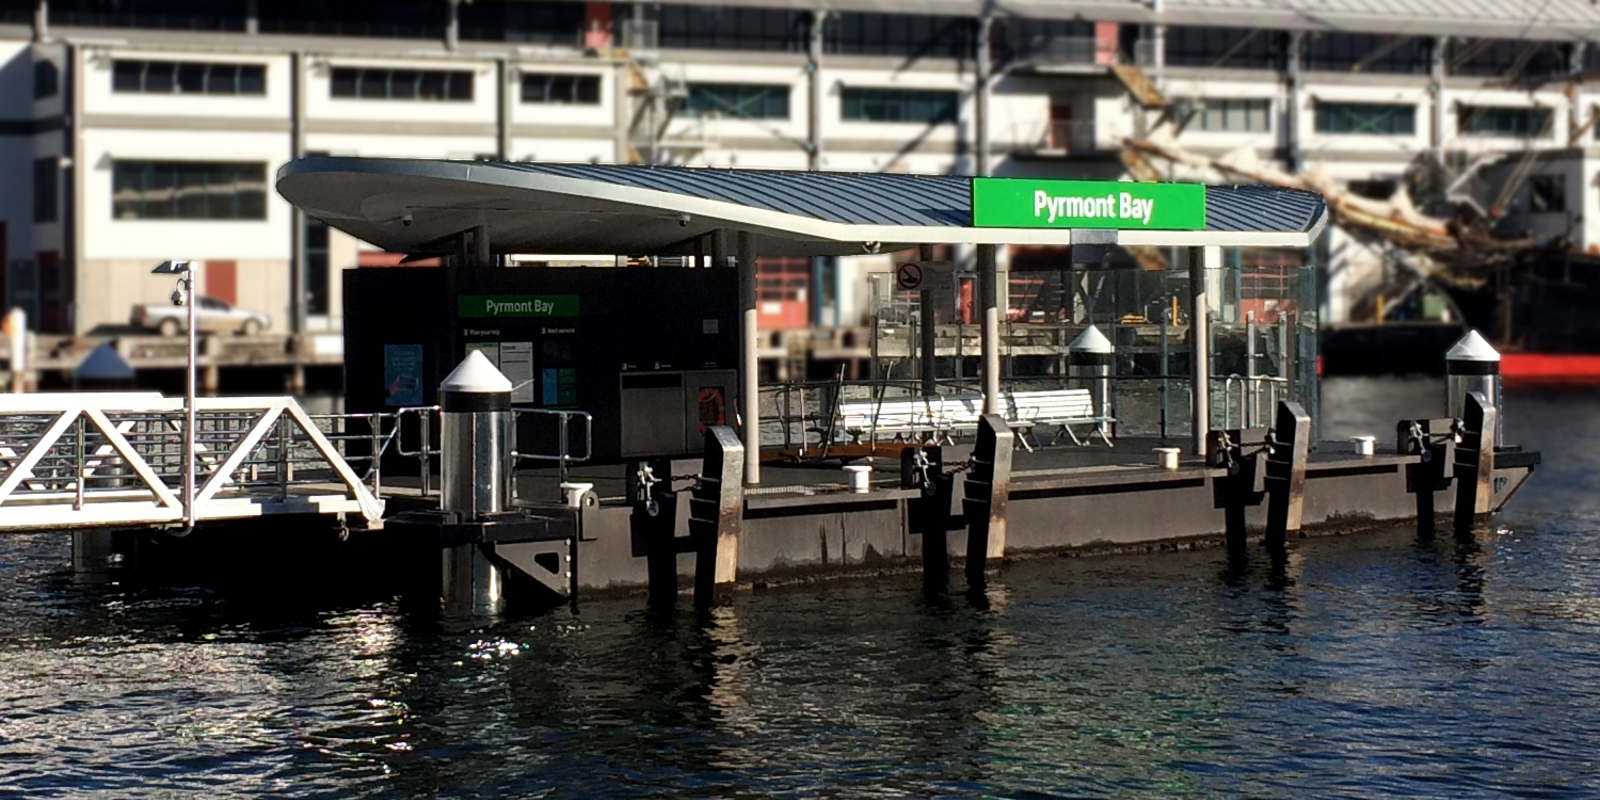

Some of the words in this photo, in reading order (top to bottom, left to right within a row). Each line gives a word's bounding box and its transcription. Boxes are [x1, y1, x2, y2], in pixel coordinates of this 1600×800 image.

[1034, 190, 1116, 224] Pyrmont
[1119, 192, 1153, 225] Bay
[486, 299, 533, 315] Pyrmont
[534, 299, 554, 315] Bay
